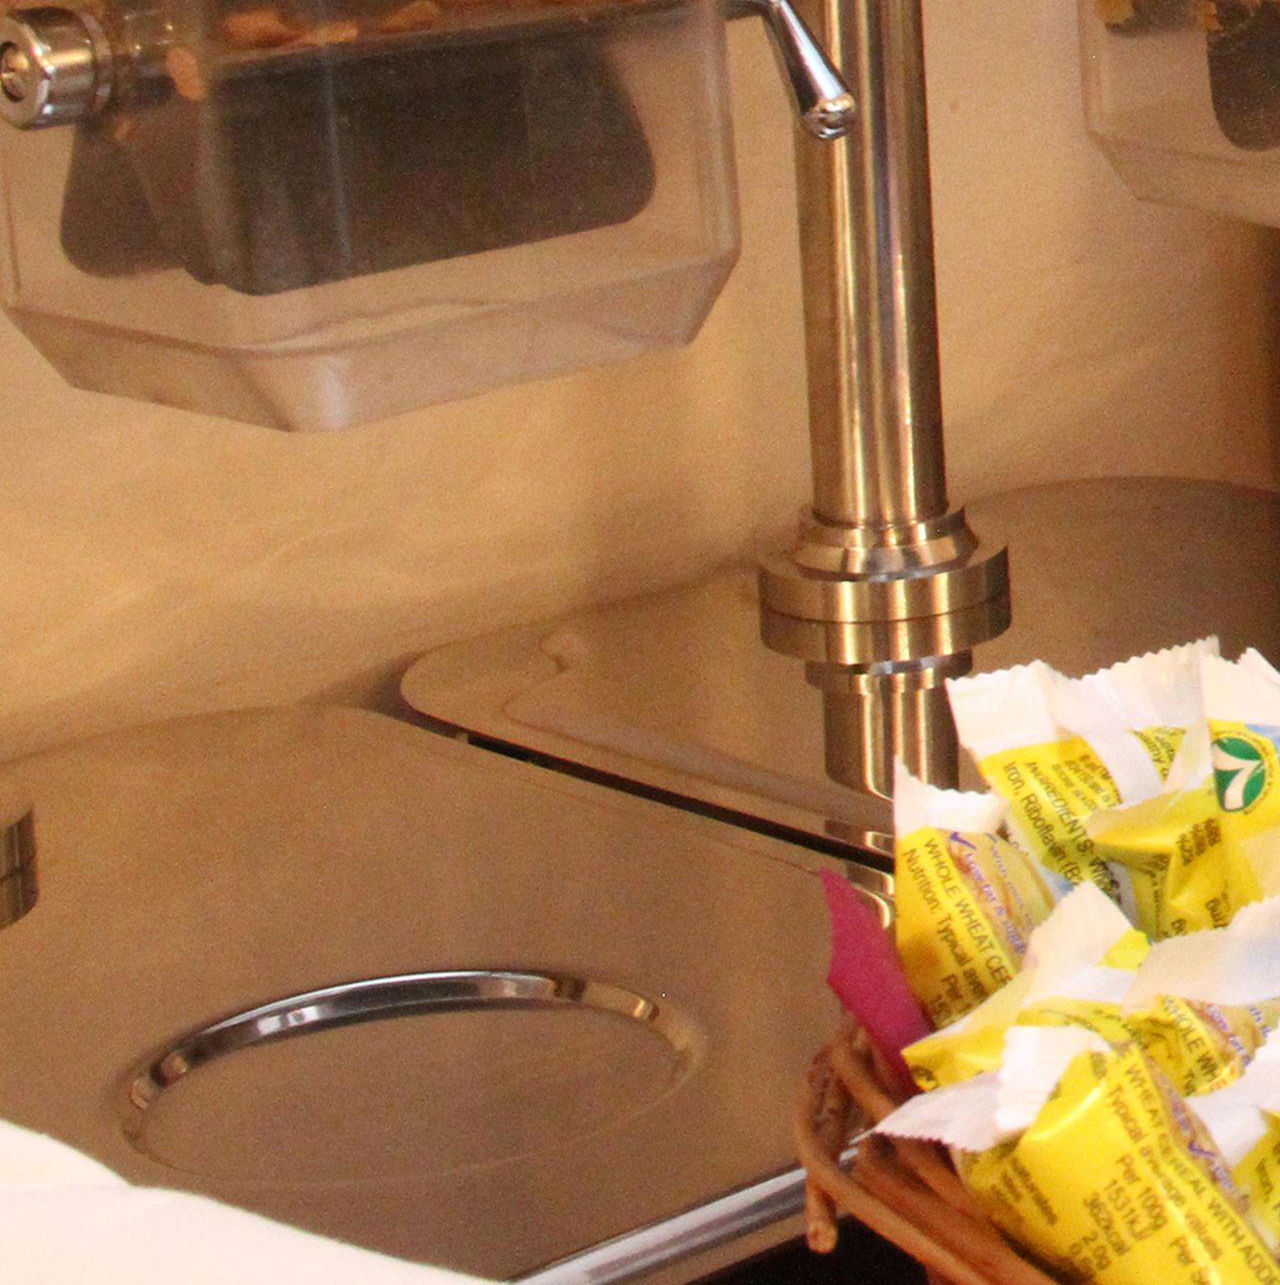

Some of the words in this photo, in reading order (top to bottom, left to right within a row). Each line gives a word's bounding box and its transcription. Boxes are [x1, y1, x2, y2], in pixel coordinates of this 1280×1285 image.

[1000, 760, 1029, 795] Iron,
[1018, 791, 1070, 864] Riboflavin
[900, 847, 943, 916] Nutrition:
[934, 913, 974, 968] Typical
[922, 837, 961, 899] WHOLE
[952, 897, 992, 956] WHEAT
[1104, 1085, 1149, 1146] Typical
[1136, 1143, 1188, 1211] average
[1181, 1207, 1226, 1261] values
[1114, 1152, 1145, 1189] Per
[1134, 1185, 1172, 1231] 100g
[1122, 1063, 1168, 1133] WHEAT
[1204, 1197, 1247, 1247] WITH
[1237, 1241, 1278, 1285] ADD
